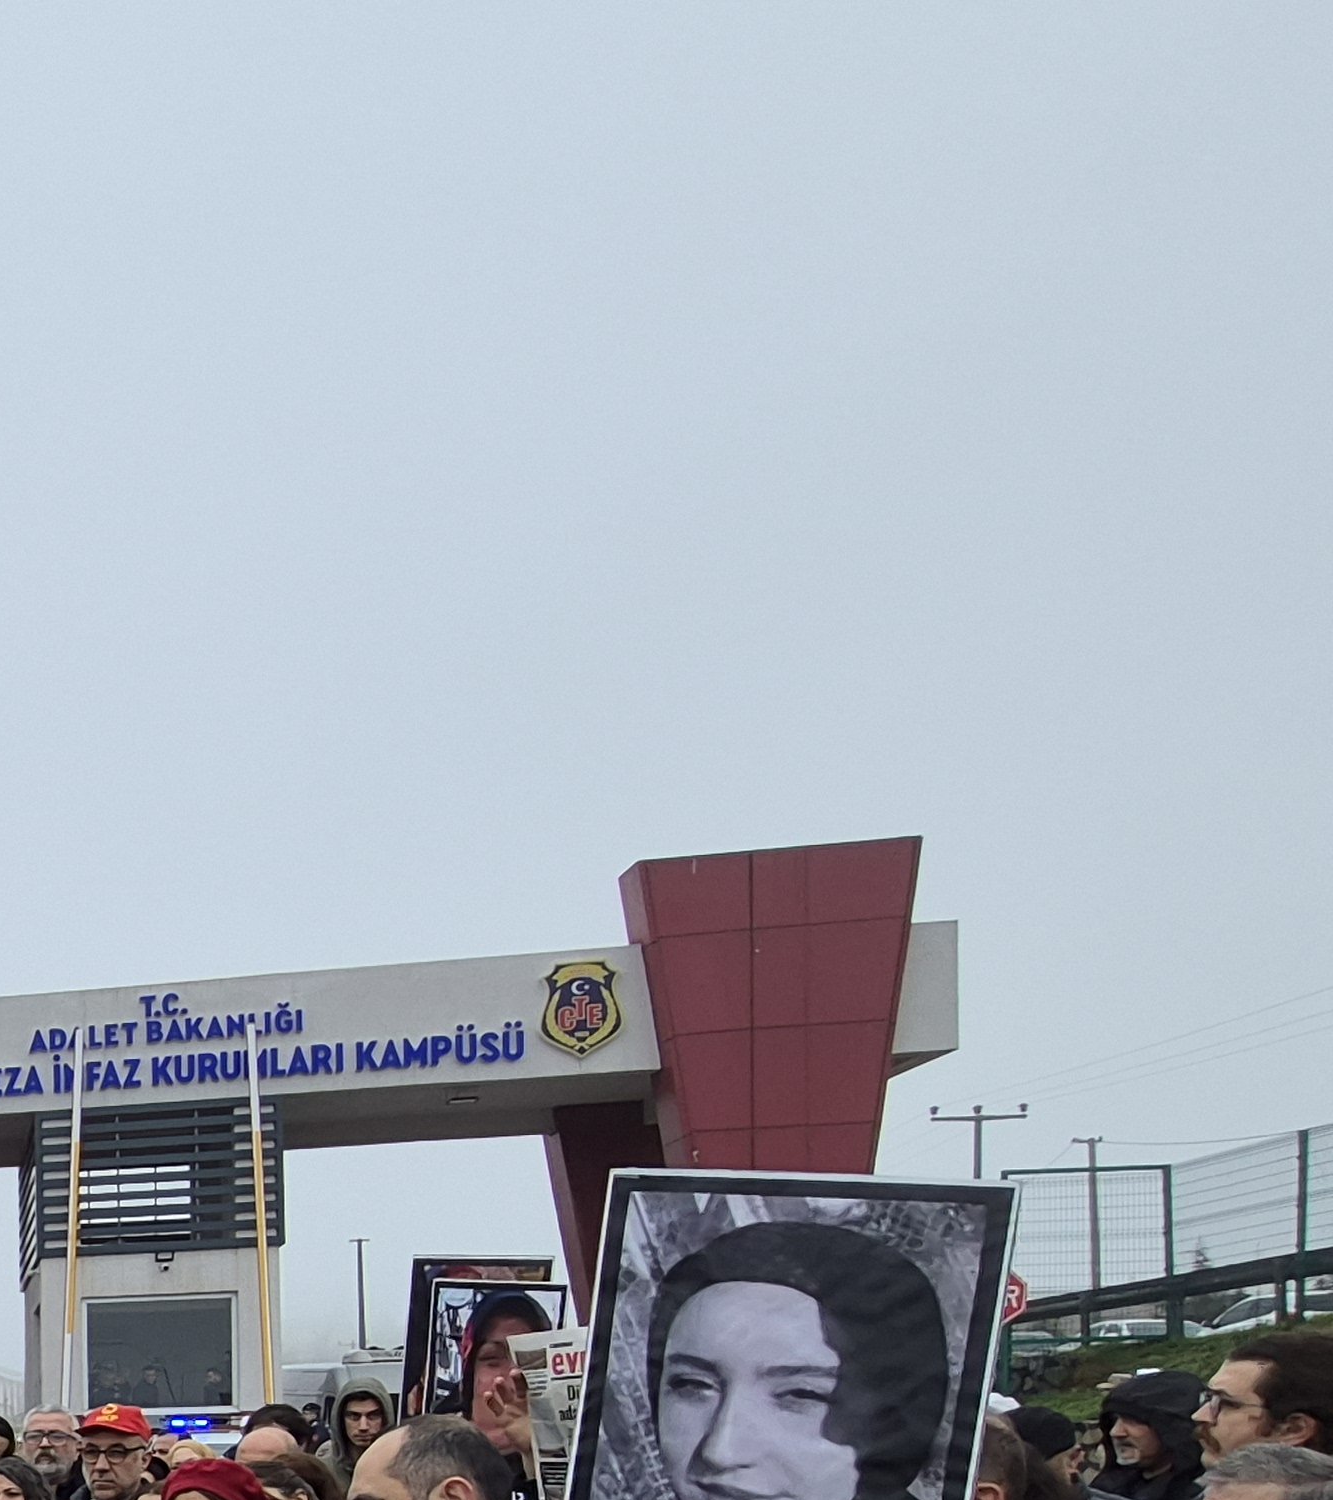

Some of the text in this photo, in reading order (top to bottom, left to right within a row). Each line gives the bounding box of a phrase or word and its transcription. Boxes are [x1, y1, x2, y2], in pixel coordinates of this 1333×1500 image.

[29, 1002, 304, 1055] ADALET BAKANLIĞI
[139, 993, 188, 1018] T.C.
[52, 1053, 142, 1095] İNFAZ
[151, 1042, 344, 1087] KURUMLARI
[355, 1020, 525, 1073] KAMPÜSÜ
